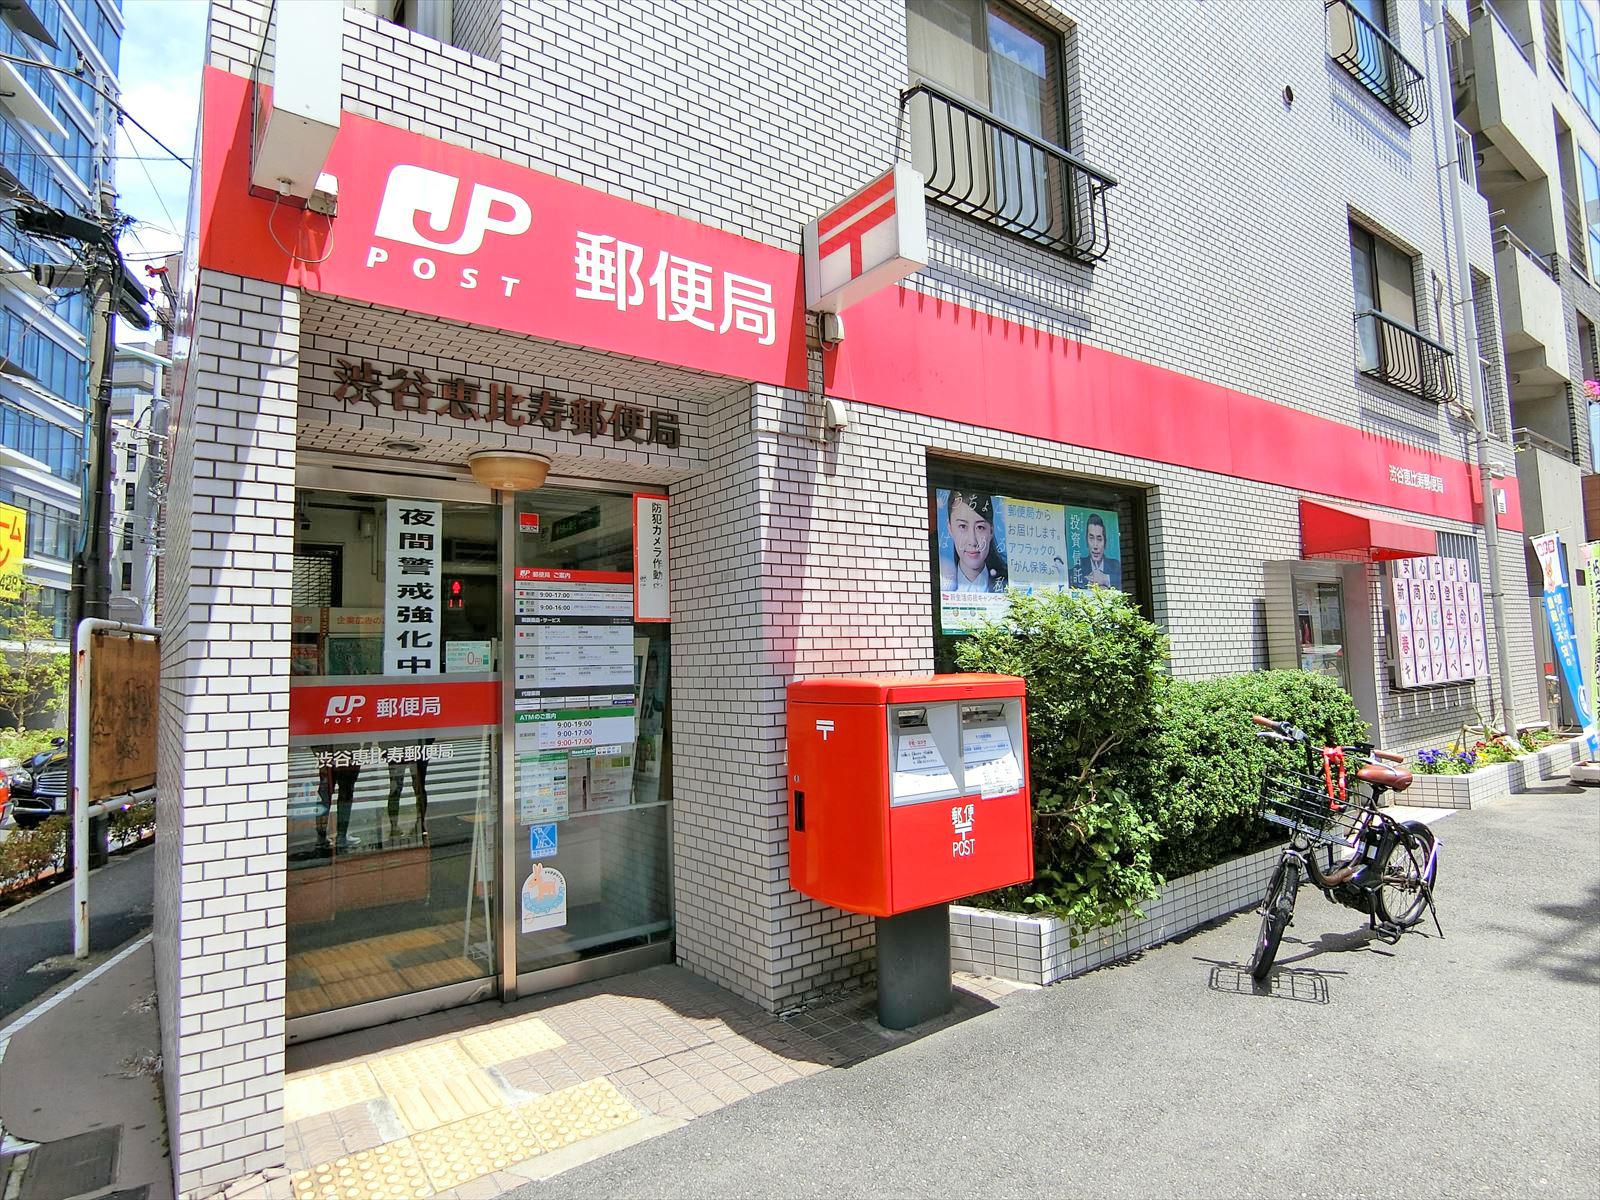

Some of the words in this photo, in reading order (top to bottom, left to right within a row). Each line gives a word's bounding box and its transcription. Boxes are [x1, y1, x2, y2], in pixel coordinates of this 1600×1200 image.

[373, 163, 533, 256] JP
[366, 245, 521, 298] POST
[573, 230, 777, 347] 郵便局
[332, 357, 681, 449] 渋谷恵比寿郵便局
[1388, 464, 1444, 494] 渋谷恵比寿郵便局
[1007, 505, 1051, 521] 郵便局から
[1007, 524, 1061, 541] お届けします。
[1008, 542, 1056, 556] アフラックの
[1070, 514, 1084, 583] 投資信託
[1010, 559, 1055, 576] 「がん保険」。
[396, 508, 435, 674] 夜間警戒強化中
[539, 591, 570, 599] 9:00-17:00
[1399, 608, 1479, 627] かんぽ生命の
[1402, 658, 1484, 681] キャンペーン
[325, 695, 366, 717] JP
[376, 696, 441, 718] 郵便局
[519, 712, 557, 721] ATMのご案内
[323, 717, 364, 725] POST
[557, 720, 593, 729] 9:00-19:00
[556, 738, 593, 747] 9:00-17:00
[557, 729, 593, 738] 9:00-17:00
[314, 743, 455, 769] 渋谷恵比寿郵便局
[951, 803, 975, 826] 郵便
[952, 838, 976, 858] POST
